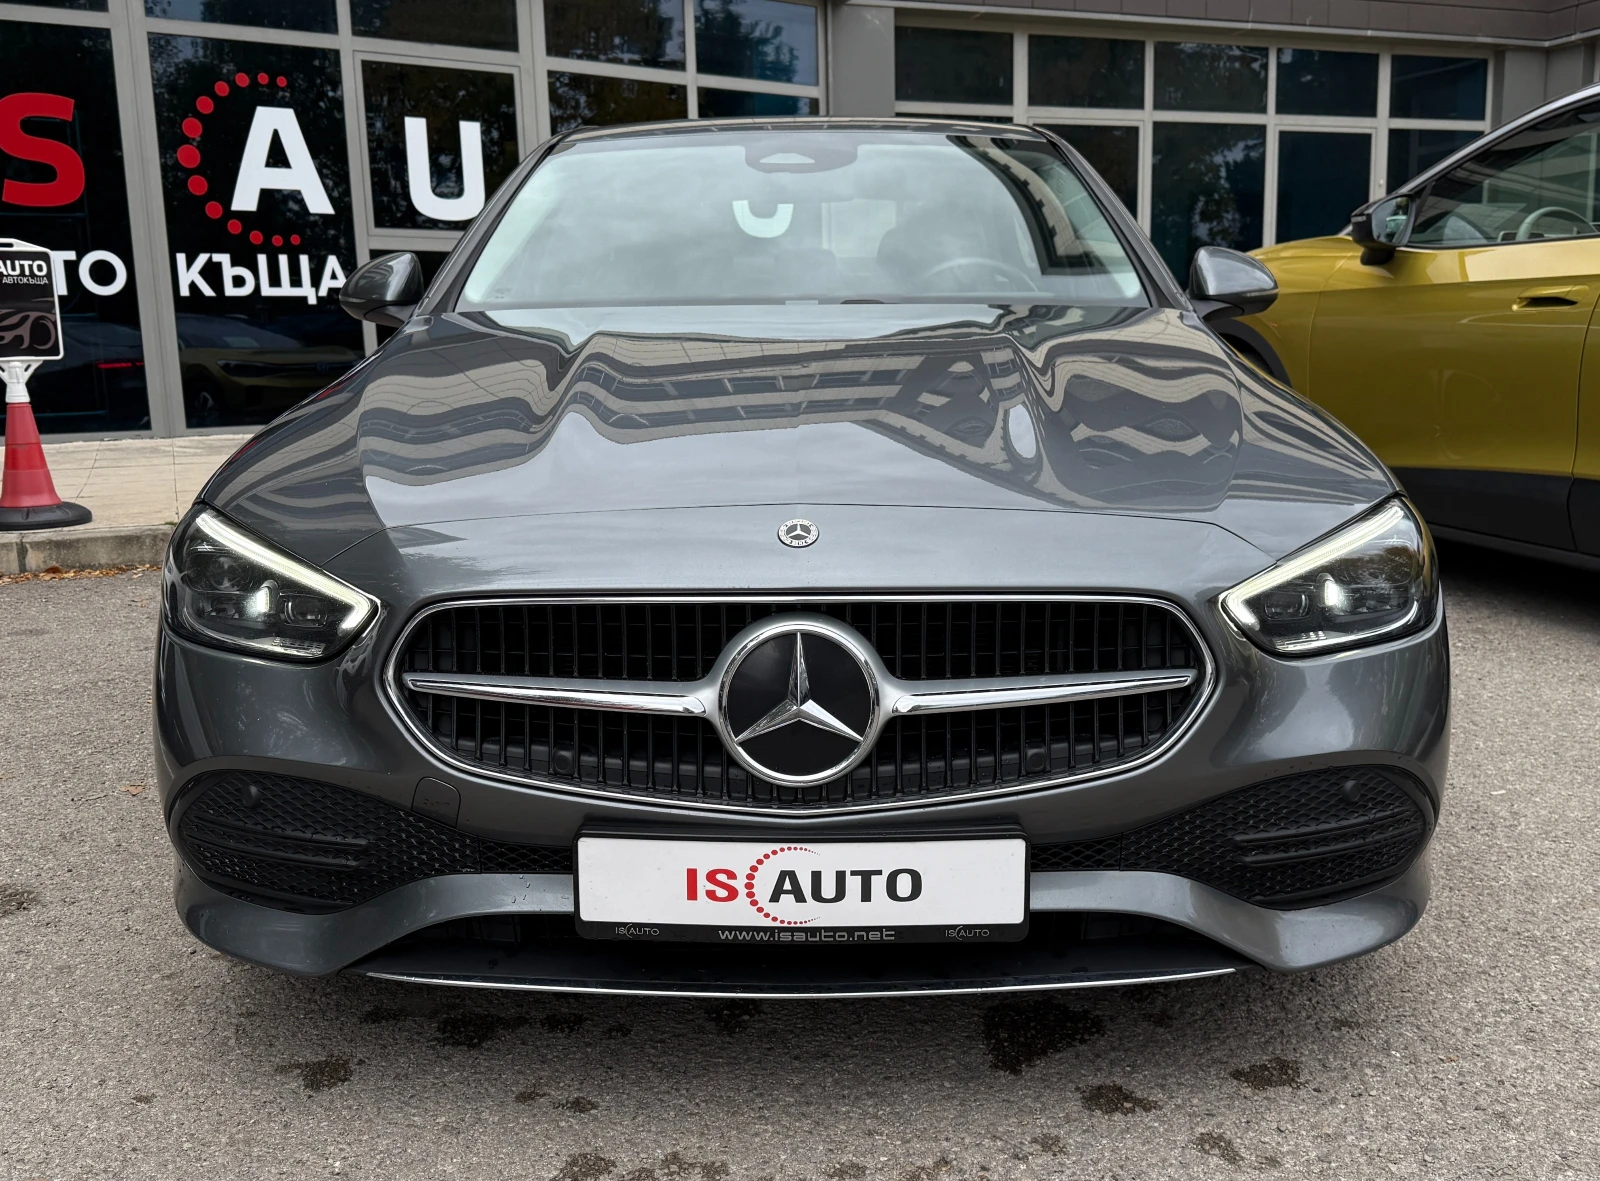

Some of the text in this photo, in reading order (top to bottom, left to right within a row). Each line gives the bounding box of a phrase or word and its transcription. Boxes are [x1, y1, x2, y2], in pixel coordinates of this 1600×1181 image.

[2, 276, 49, 285] АВТОКЪЩА
[175, 253, 347, 305] КЪЩА
[686, 868, 923, 904] IS AUTO
[718, 929, 895, 942] www.isauto.net
